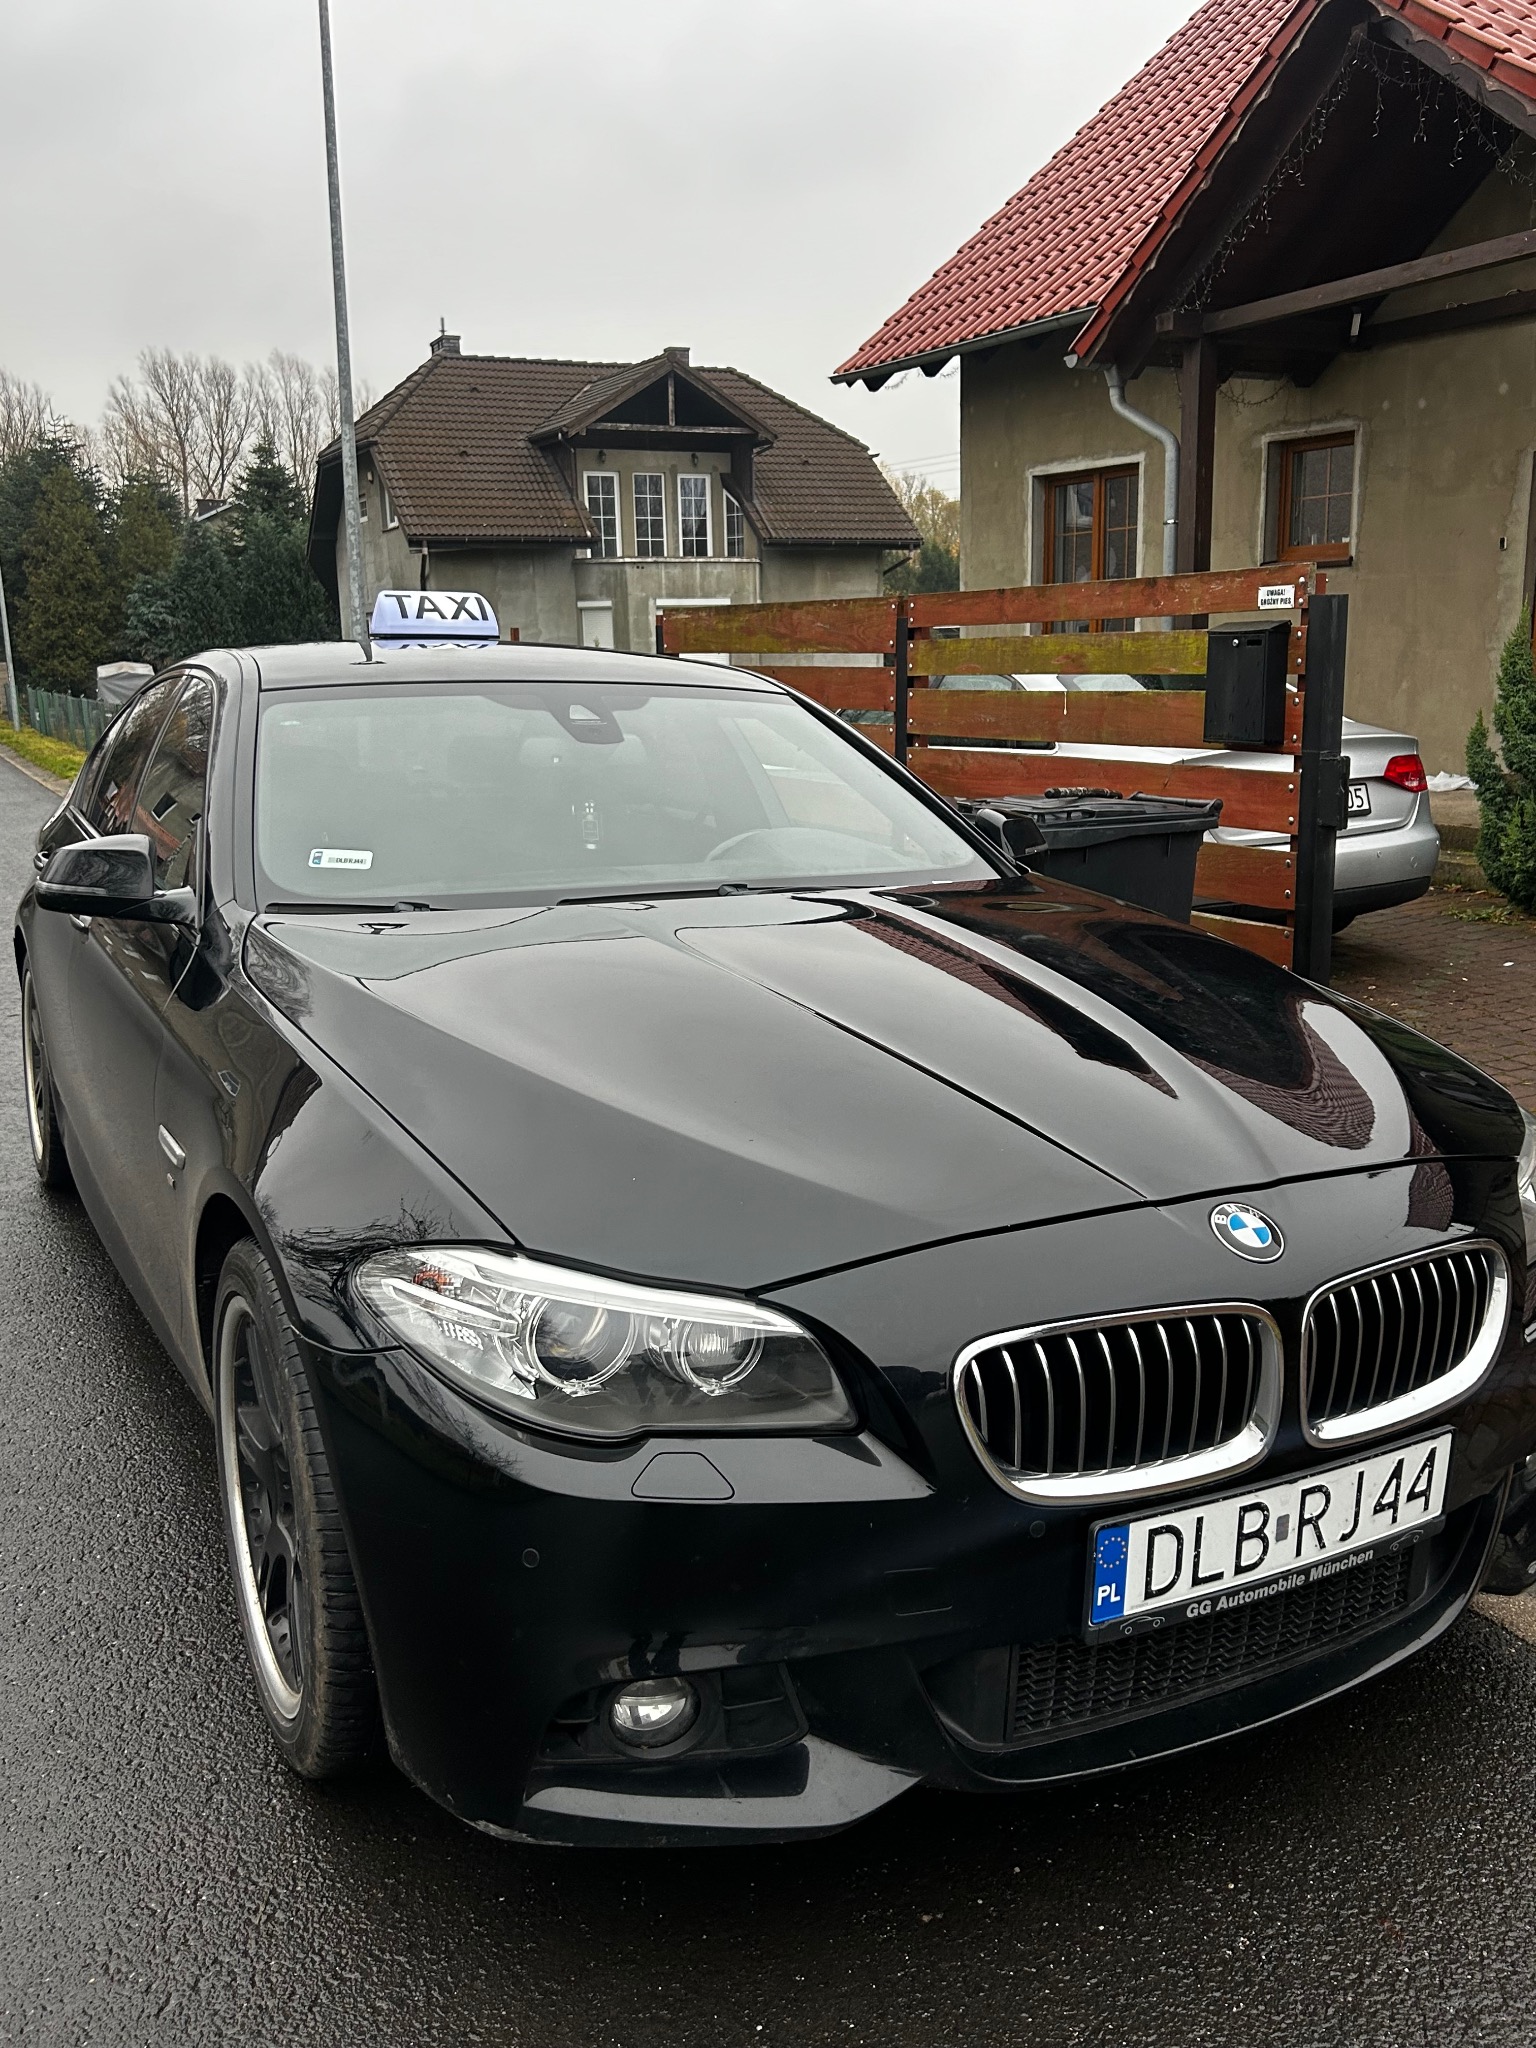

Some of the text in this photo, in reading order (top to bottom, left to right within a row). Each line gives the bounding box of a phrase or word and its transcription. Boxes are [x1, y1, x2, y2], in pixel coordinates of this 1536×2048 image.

[384, 594, 489, 621] TAXI
[1143, 1445, 1438, 1601] DLB RJ44
[1096, 1583, 1122, 1606] PL
[1186, 1549, 1374, 1618] GG Automobile München
